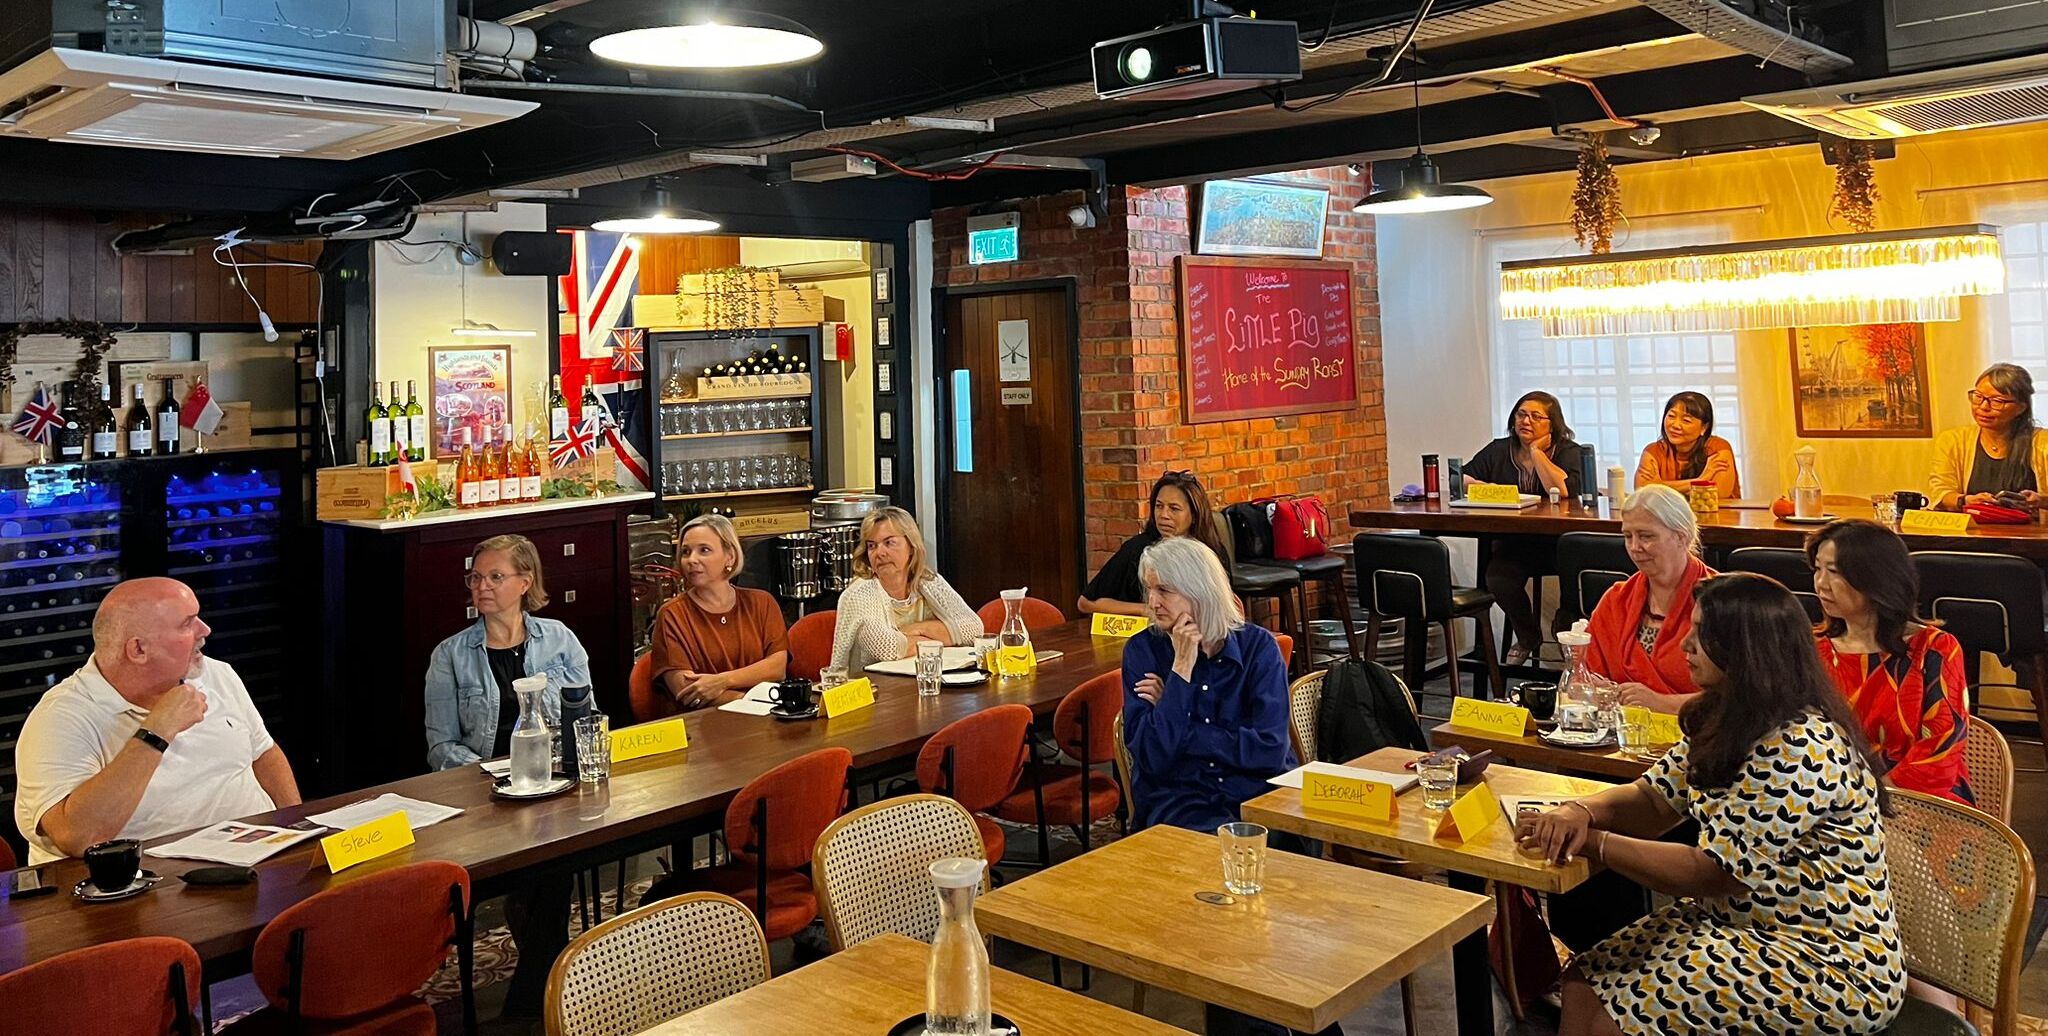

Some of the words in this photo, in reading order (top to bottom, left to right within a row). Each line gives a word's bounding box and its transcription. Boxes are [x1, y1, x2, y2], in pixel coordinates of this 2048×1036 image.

[975, 237, 996, 256] EXIT
[1245, 272, 1279, 286] Welcome
[1103, 616, 1137, 635] KAT
[619, 730, 664, 751] KAREN
[1313, 780, 1366, 804] DEBORAH
[341, 831, 383, 854] Steve
